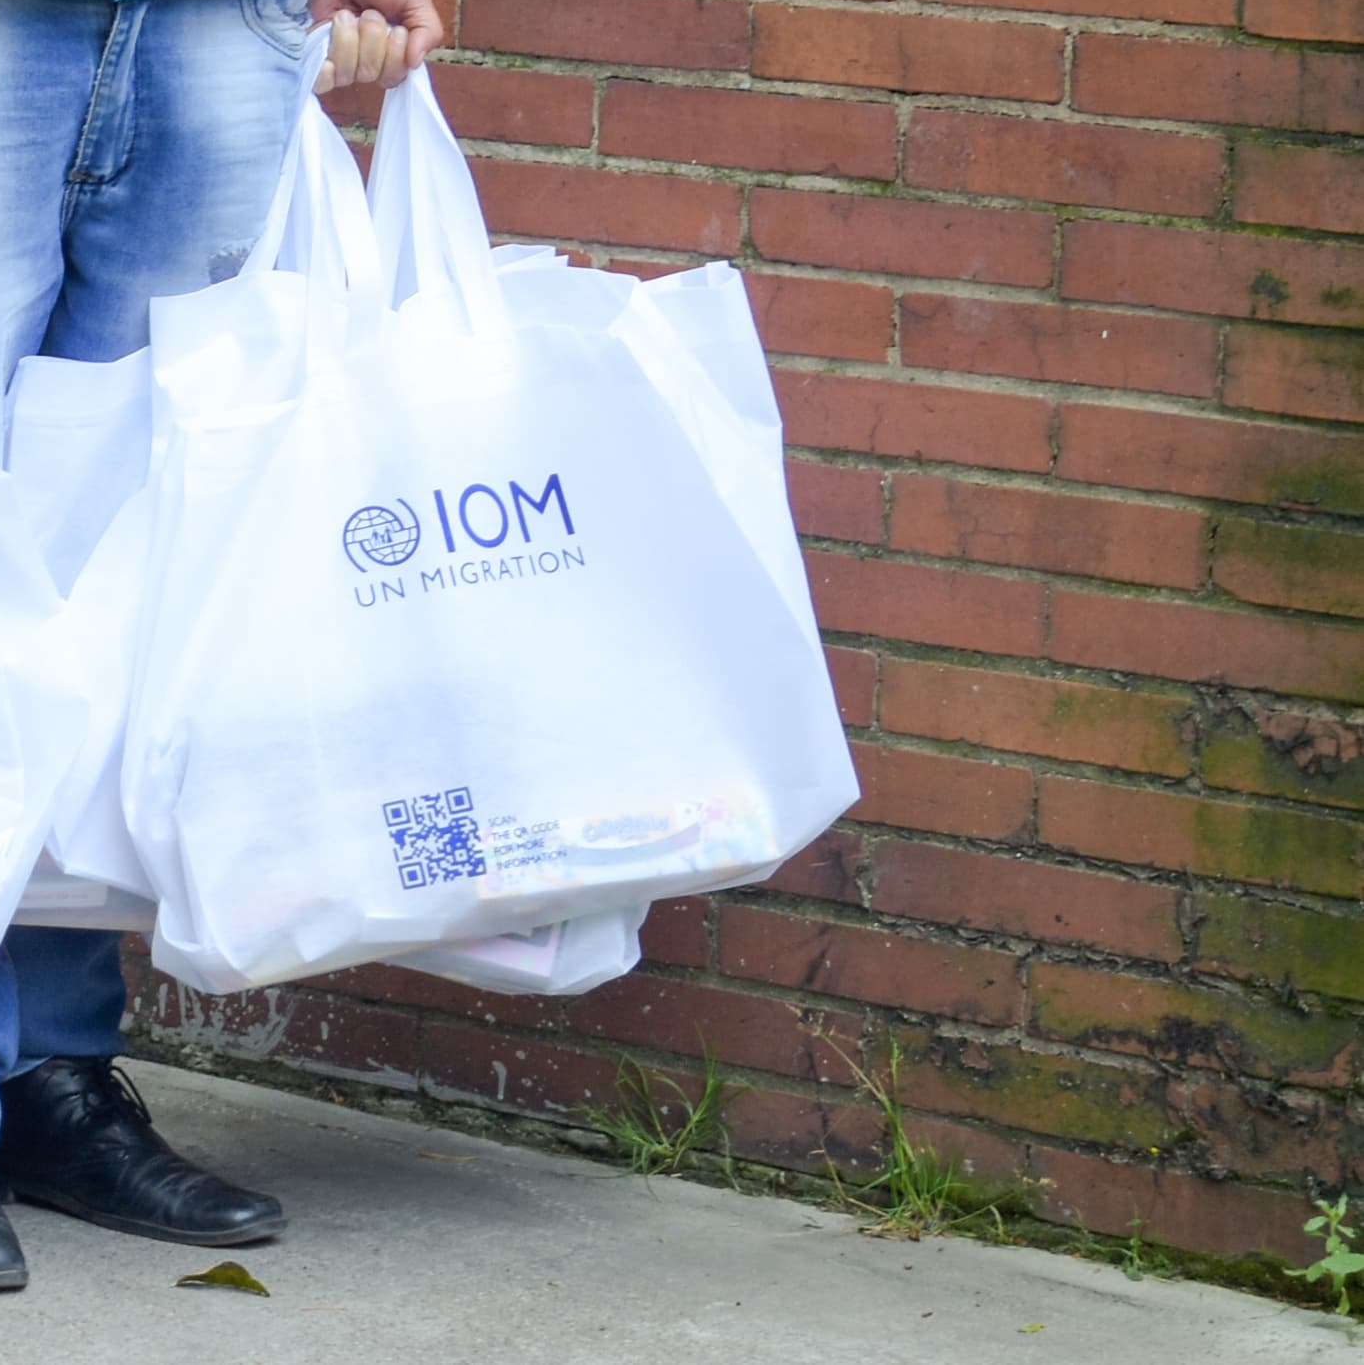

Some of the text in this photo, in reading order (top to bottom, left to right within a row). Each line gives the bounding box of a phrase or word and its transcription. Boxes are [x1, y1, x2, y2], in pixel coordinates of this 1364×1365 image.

[433, 473, 575, 553] IOM
[354, 546, 586, 608] UN MIGRATION
[496, 849, 568, 870] INFORMATION
